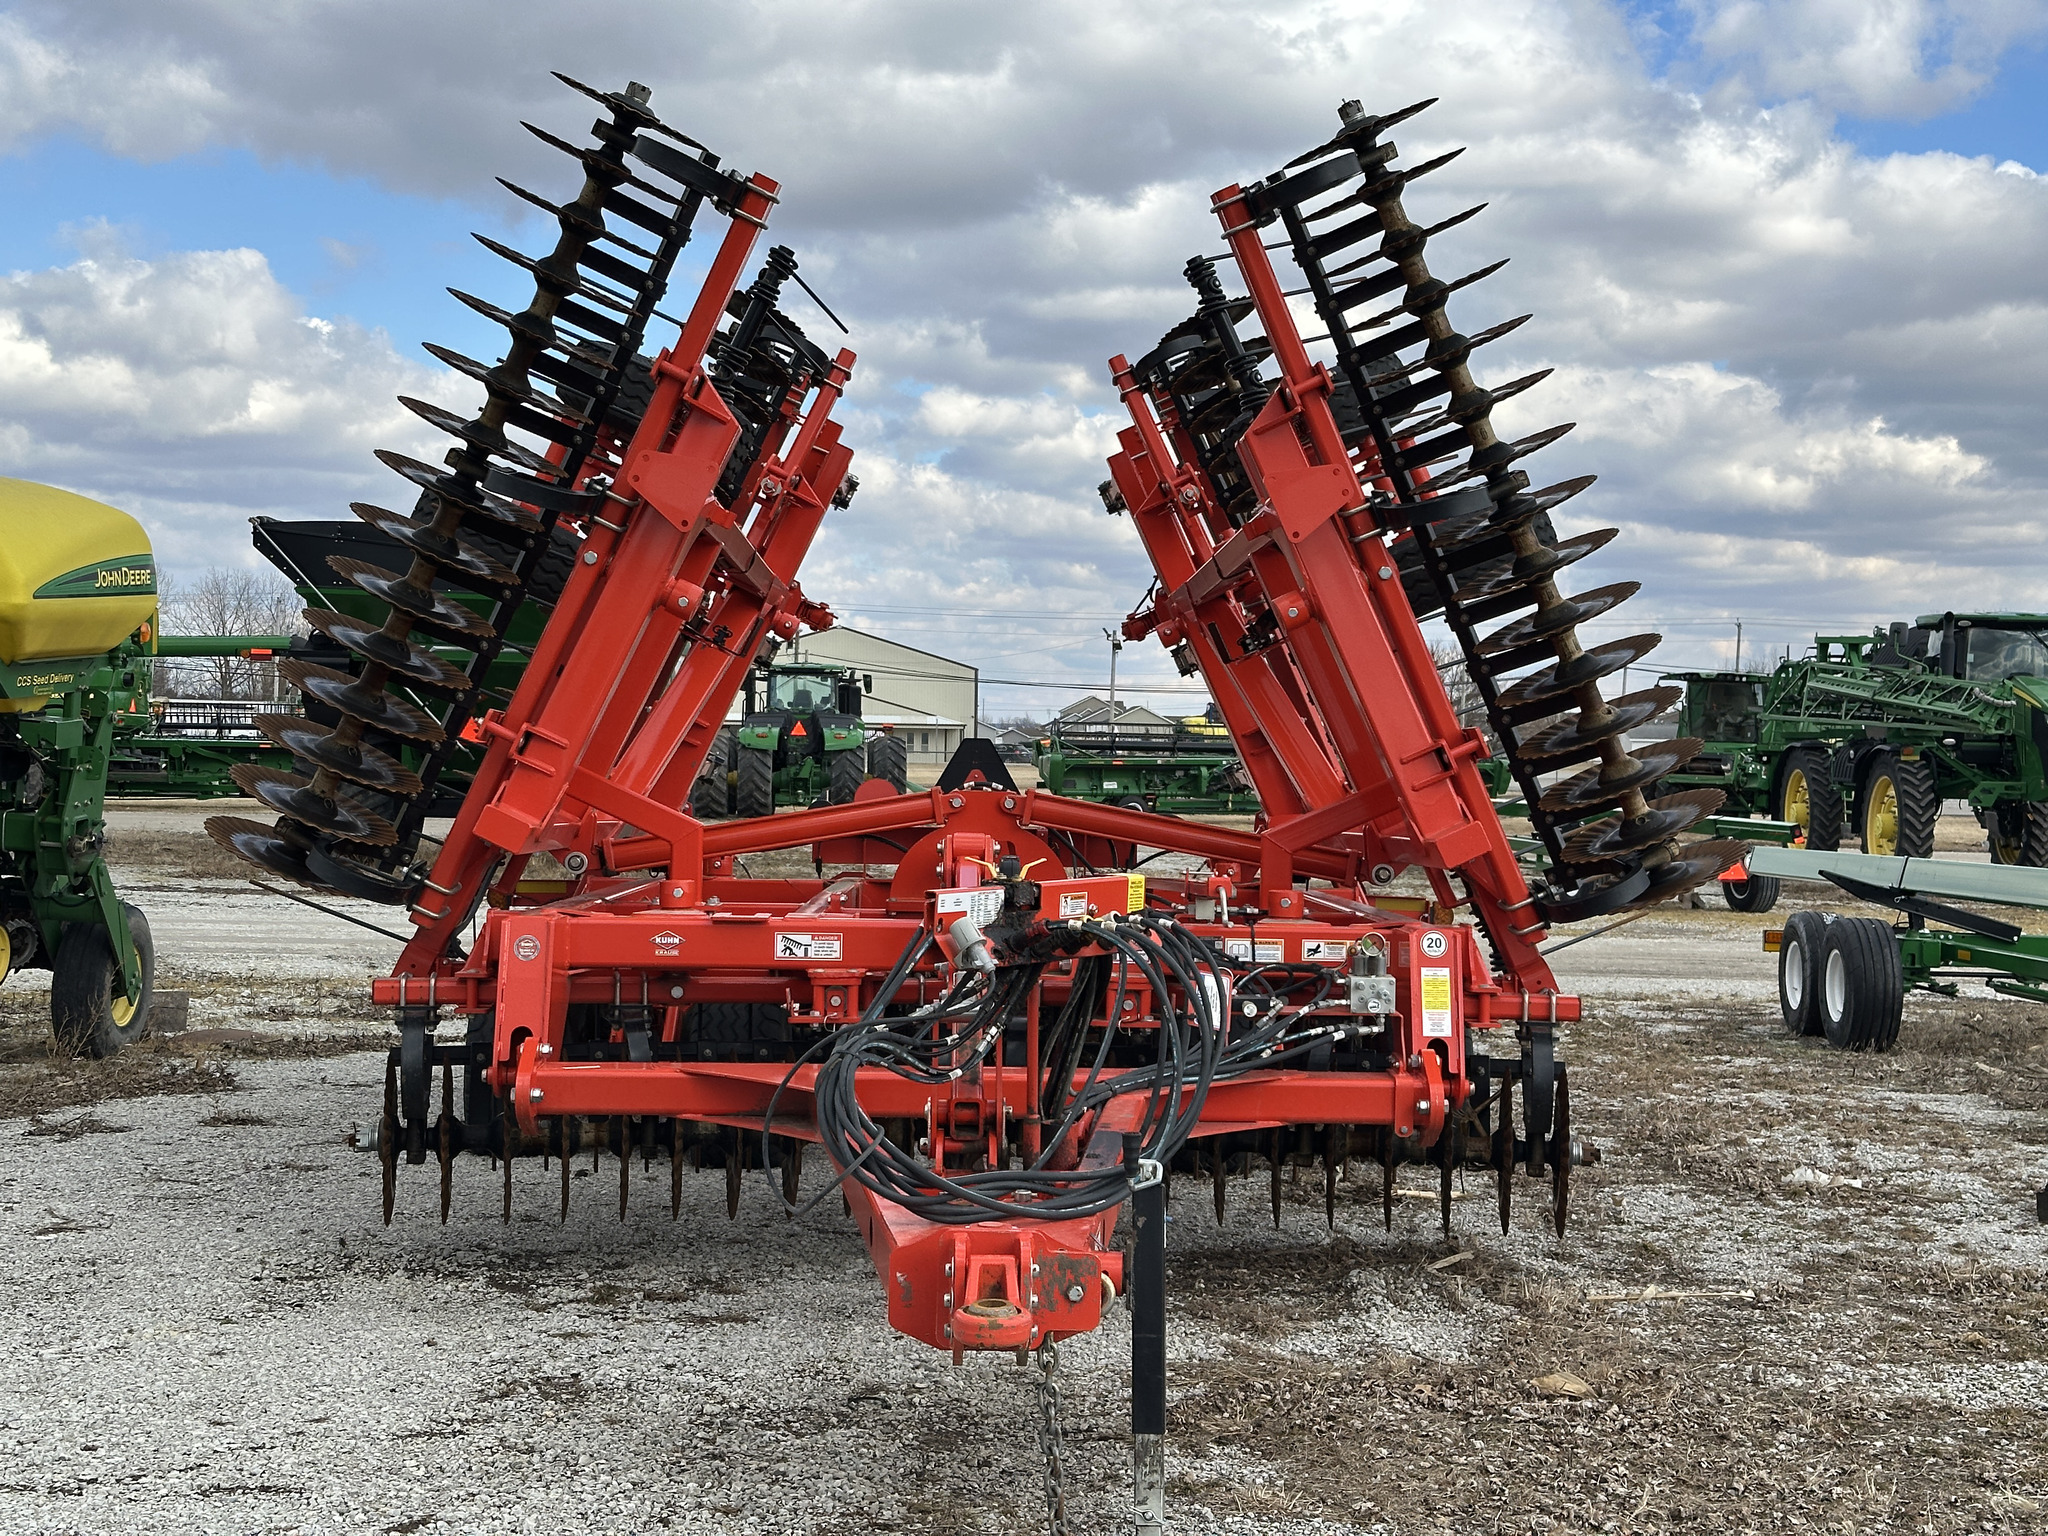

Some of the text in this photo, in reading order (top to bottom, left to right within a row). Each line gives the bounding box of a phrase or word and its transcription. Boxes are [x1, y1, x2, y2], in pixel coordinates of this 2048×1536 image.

[94, 566, 151, 588] JOHN DEERE
[16, 673, 75, 687] CCS Seed Delivery
[655, 936, 680, 944] KUHN
[1426, 937, 1442, 949] 20
